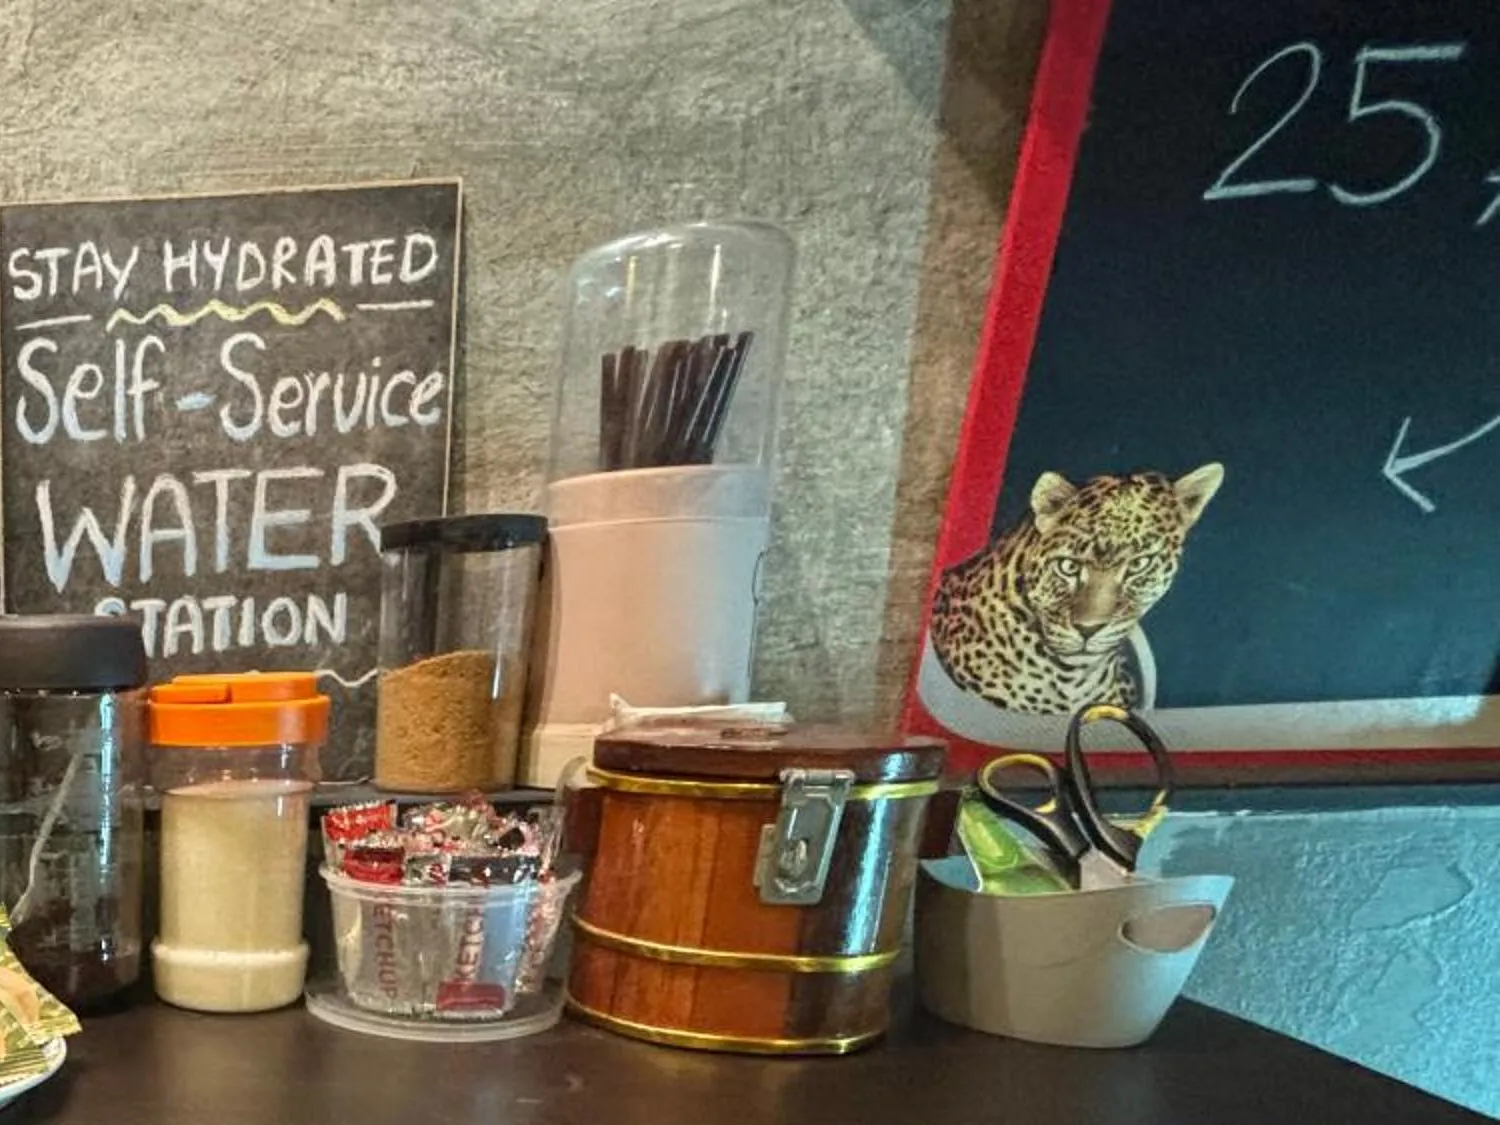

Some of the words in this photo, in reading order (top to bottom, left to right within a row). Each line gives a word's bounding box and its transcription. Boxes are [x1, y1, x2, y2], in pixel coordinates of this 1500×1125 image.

[7, 240, 140, 301] STAY
[162, 233, 440, 293] HYDRATED
[14, 331, 445, 446] Self-Service
[35, 462, 397, 594] WATER
[372, 903, 399, 999] ETCHUP
